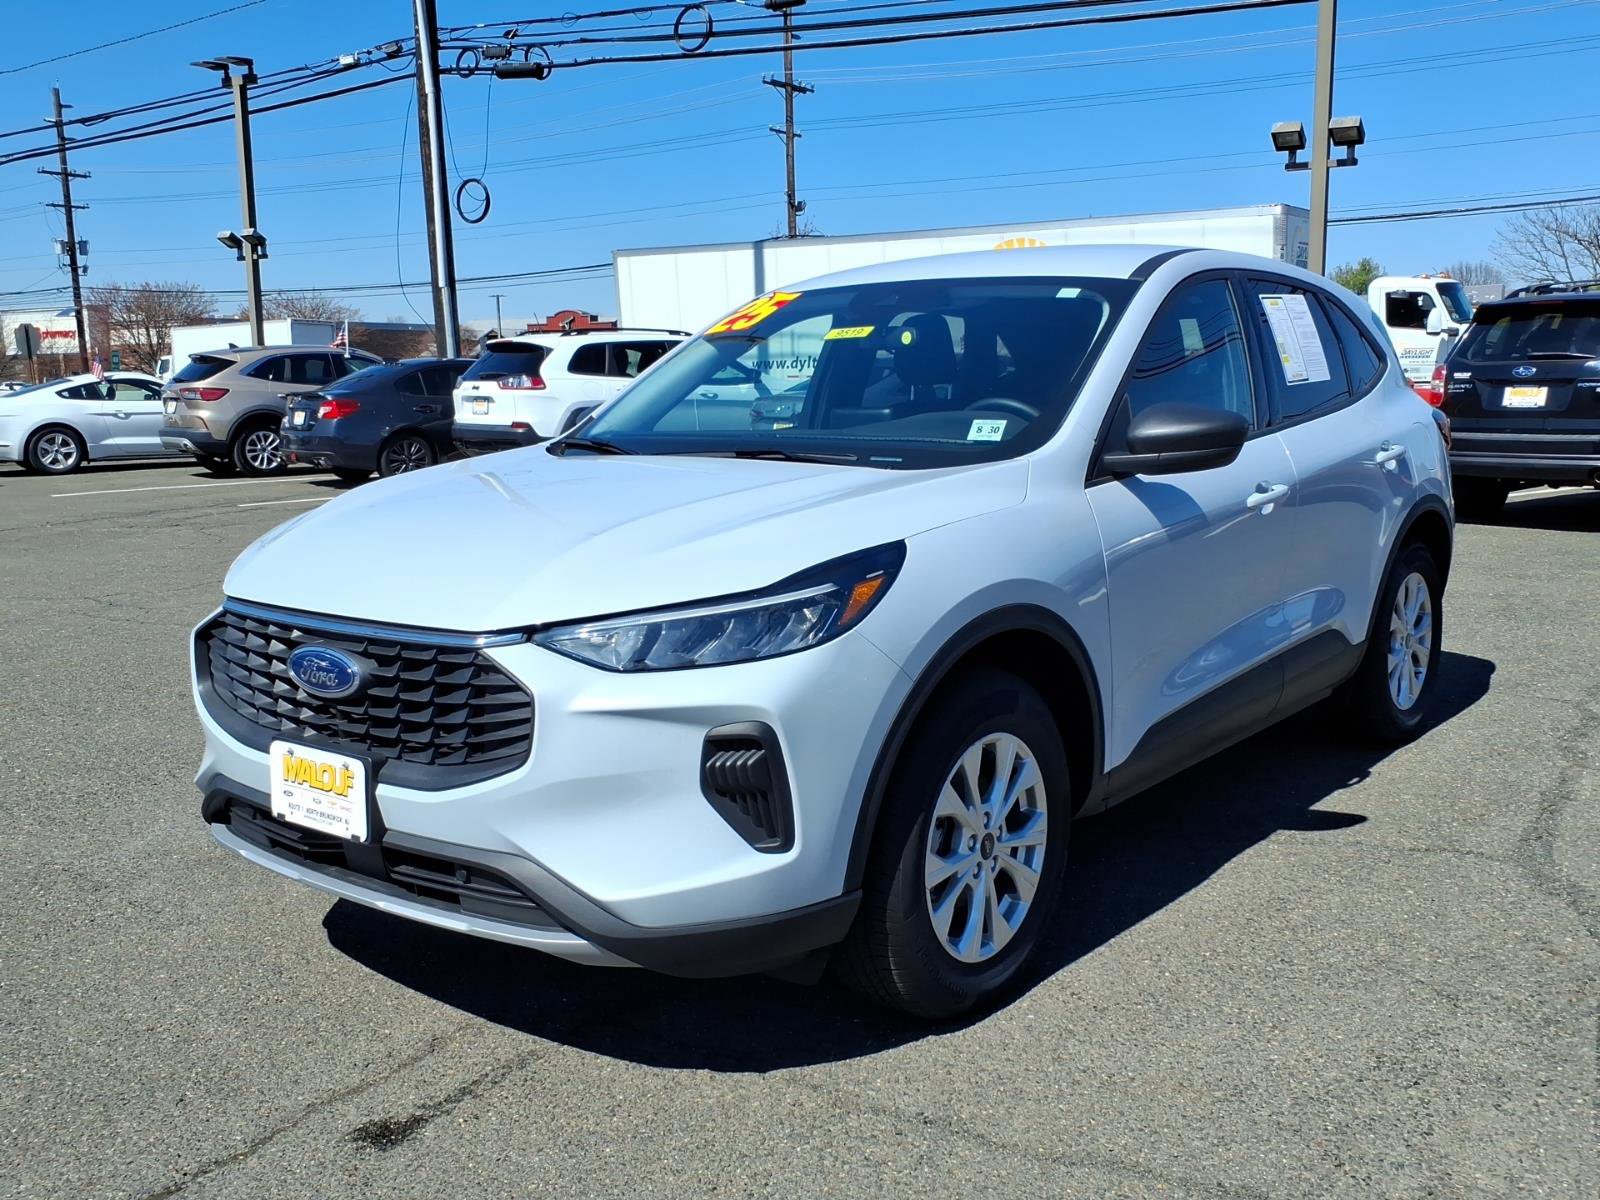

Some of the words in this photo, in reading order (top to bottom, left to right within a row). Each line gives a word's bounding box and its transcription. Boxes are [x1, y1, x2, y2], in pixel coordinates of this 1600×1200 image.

[41, 329, 76, 341] pharmacy
[835, 329, 864, 338] 9519
[975, 425, 983, 434] 8
[987, 425, 1000, 435] 30
[300, 657, 339, 687] Ford
[282, 754, 355, 798] MALOUF
